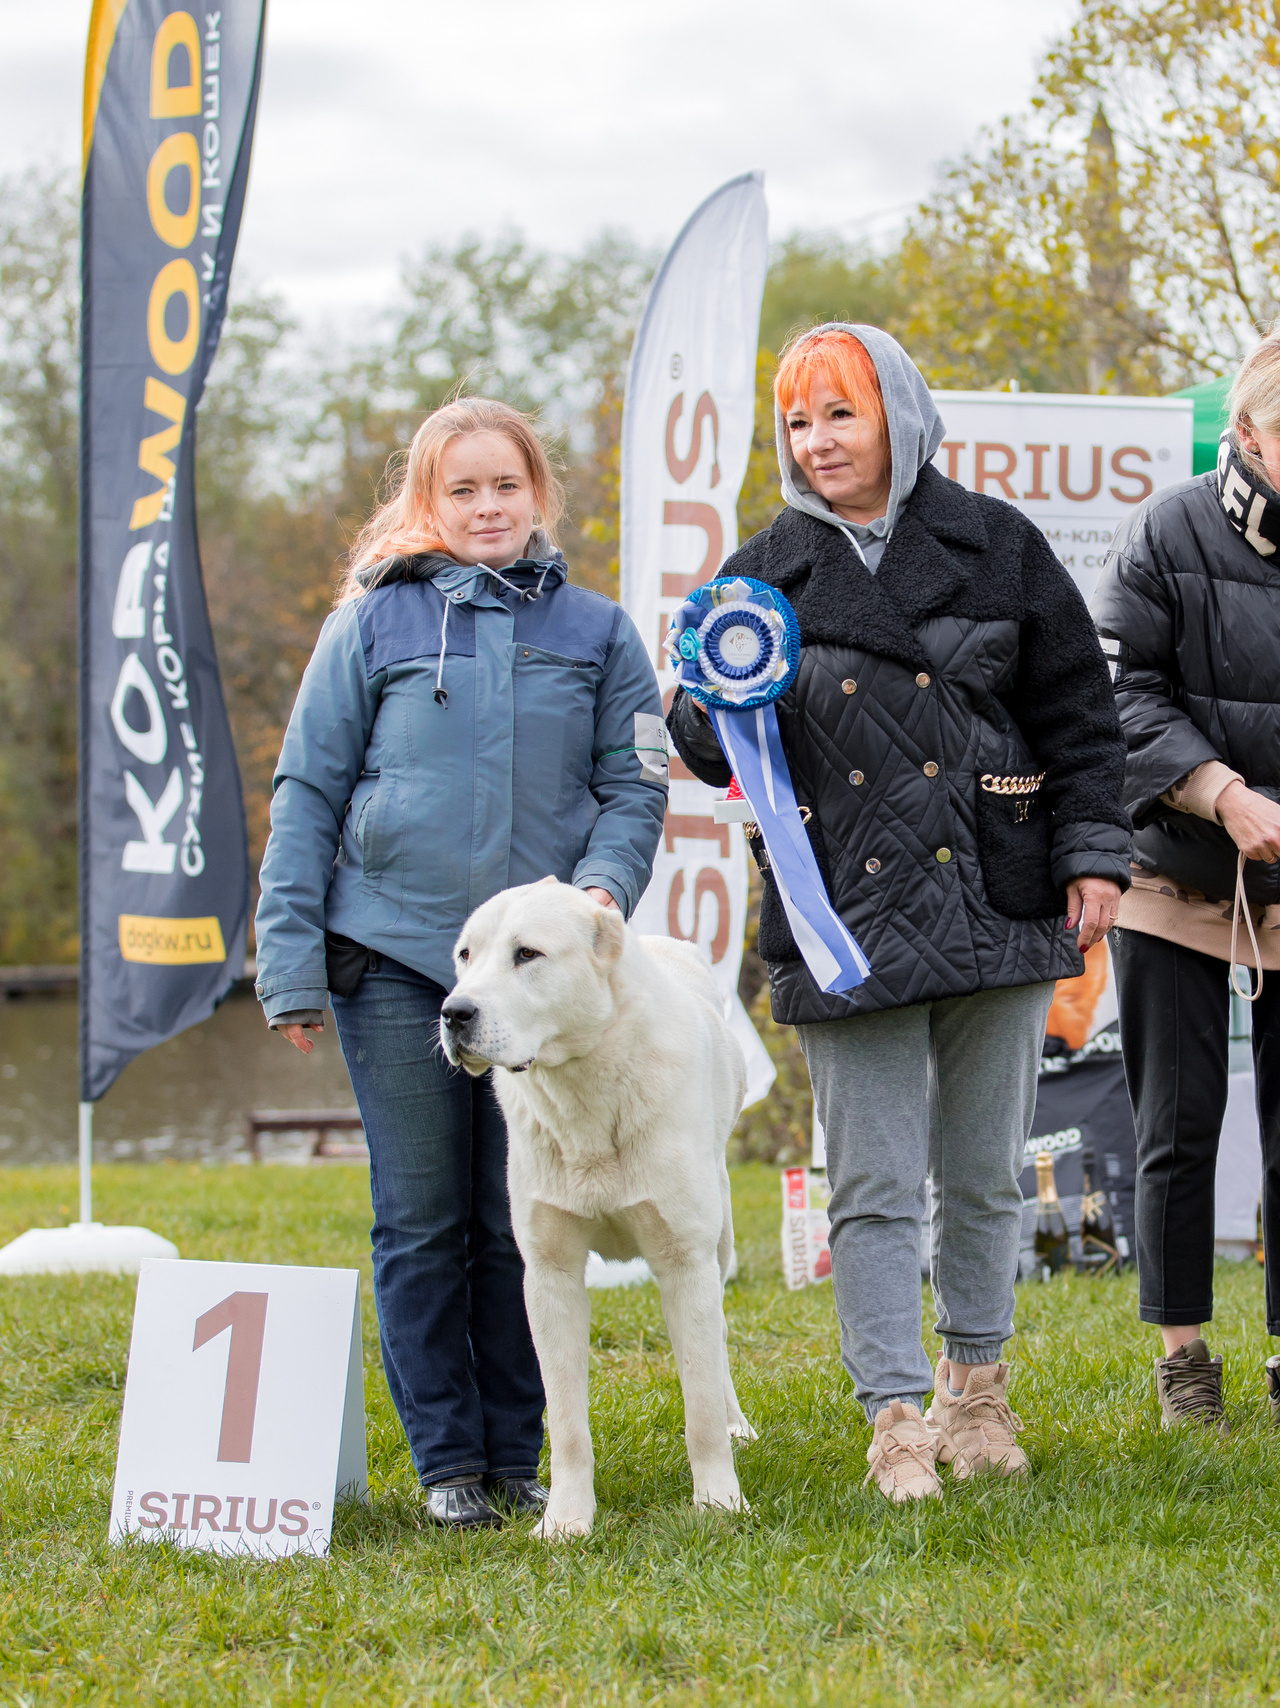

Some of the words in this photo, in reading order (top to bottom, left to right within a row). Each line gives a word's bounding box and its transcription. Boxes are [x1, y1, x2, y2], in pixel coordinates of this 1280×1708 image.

[202, 10, 222, 189] КОШЕК
[939, 441, 1154, 504] IRIUS
[1024, 1127, 1082, 1155] WOOD
[192, 1291, 269, 1464] 1
[137, 1491, 310, 1537] SIRIUS
